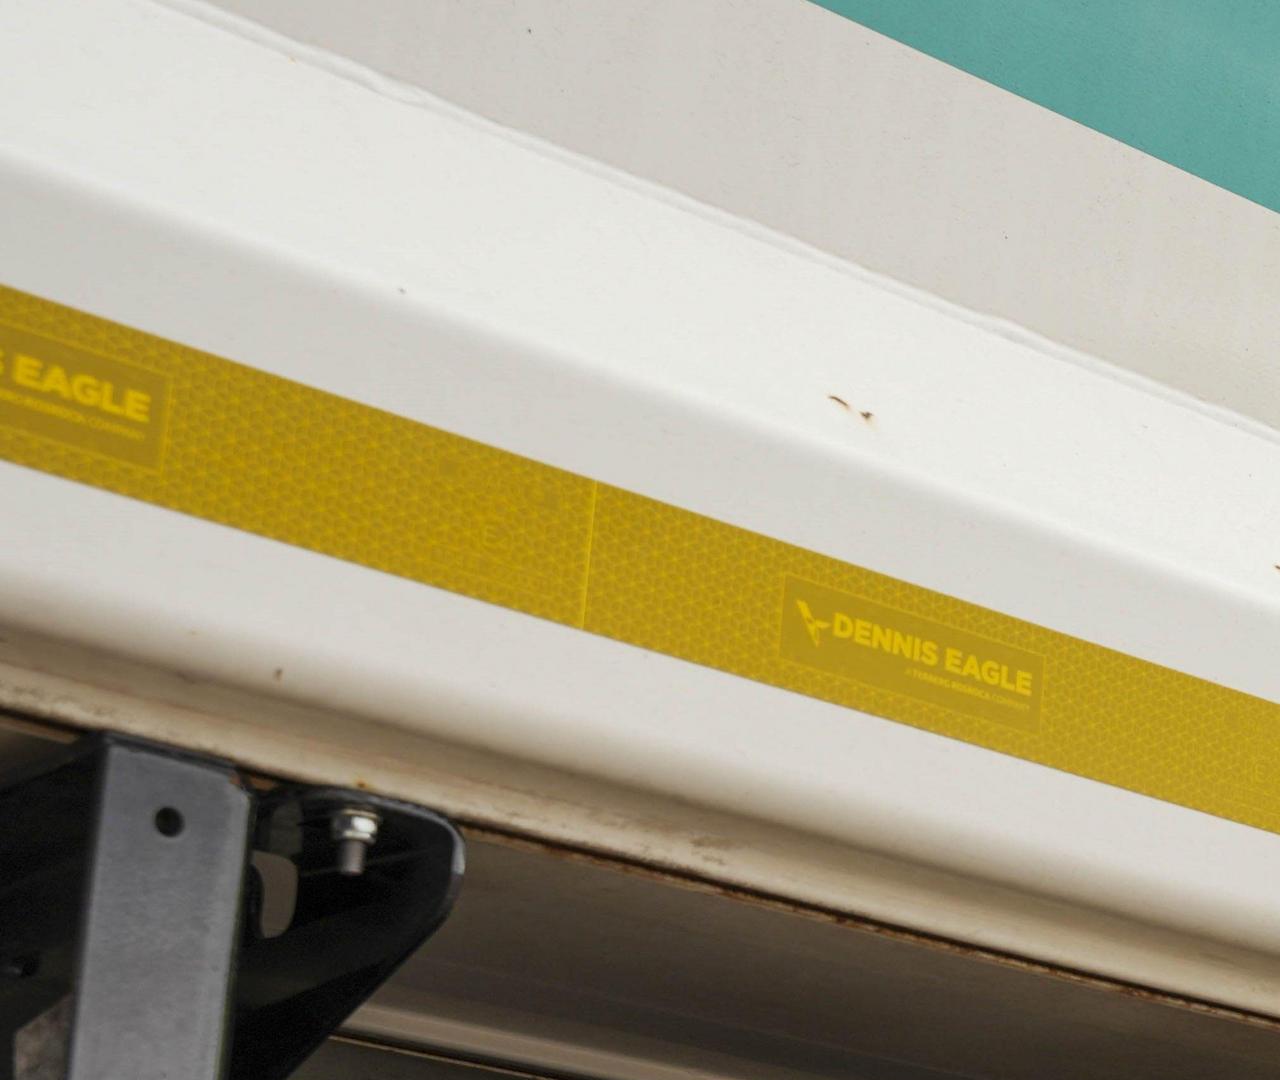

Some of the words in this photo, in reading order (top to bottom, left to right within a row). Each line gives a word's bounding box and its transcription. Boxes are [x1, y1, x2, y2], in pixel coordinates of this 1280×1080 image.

[13, 354, 151, 424] EAGLE
[833, 612, 939, 668] DENNIS
[945, 648, 1033, 697] EAGLE
